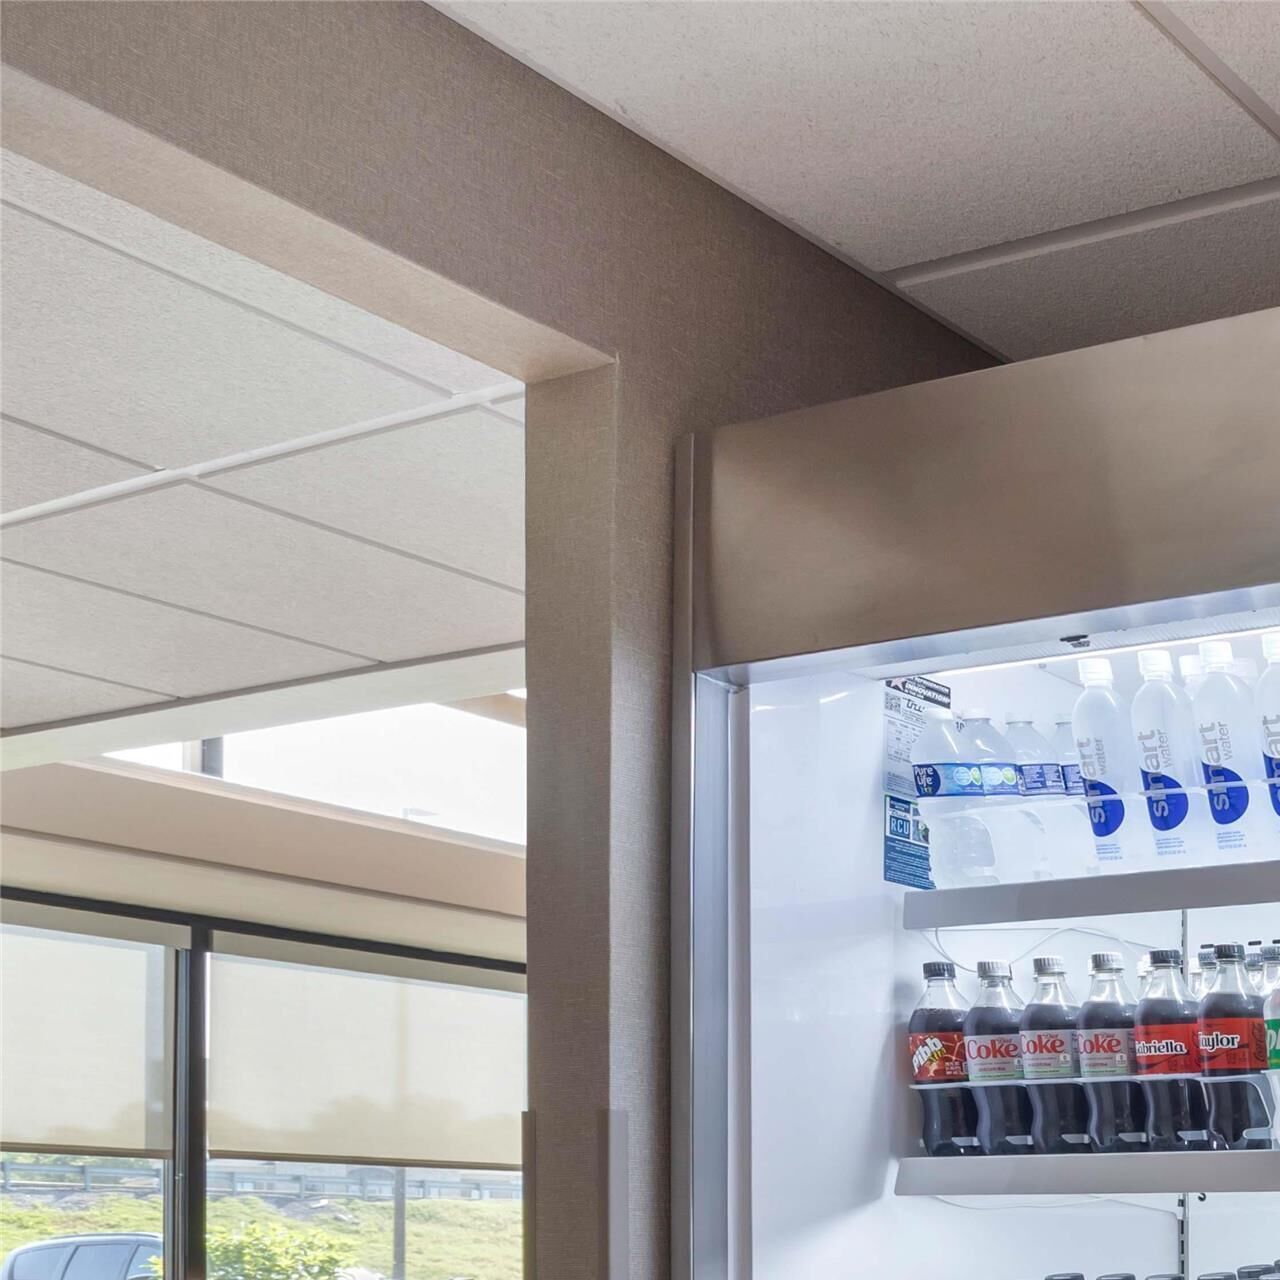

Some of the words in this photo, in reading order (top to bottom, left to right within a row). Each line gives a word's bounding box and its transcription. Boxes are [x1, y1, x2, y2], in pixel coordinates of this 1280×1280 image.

[1094, 737, 1107, 776] water
[1156, 728, 1175, 769] water
[1217, 720, 1234, 761] water
[914, 766, 933, 778] Pure
[916, 775, 934, 788] Life
[1137, 728, 1170, 818] smart
[1200, 721, 1231, 812] smart
[890, 817, 910, 835] RCU
[966, 1038, 1019, 1061] Coke
